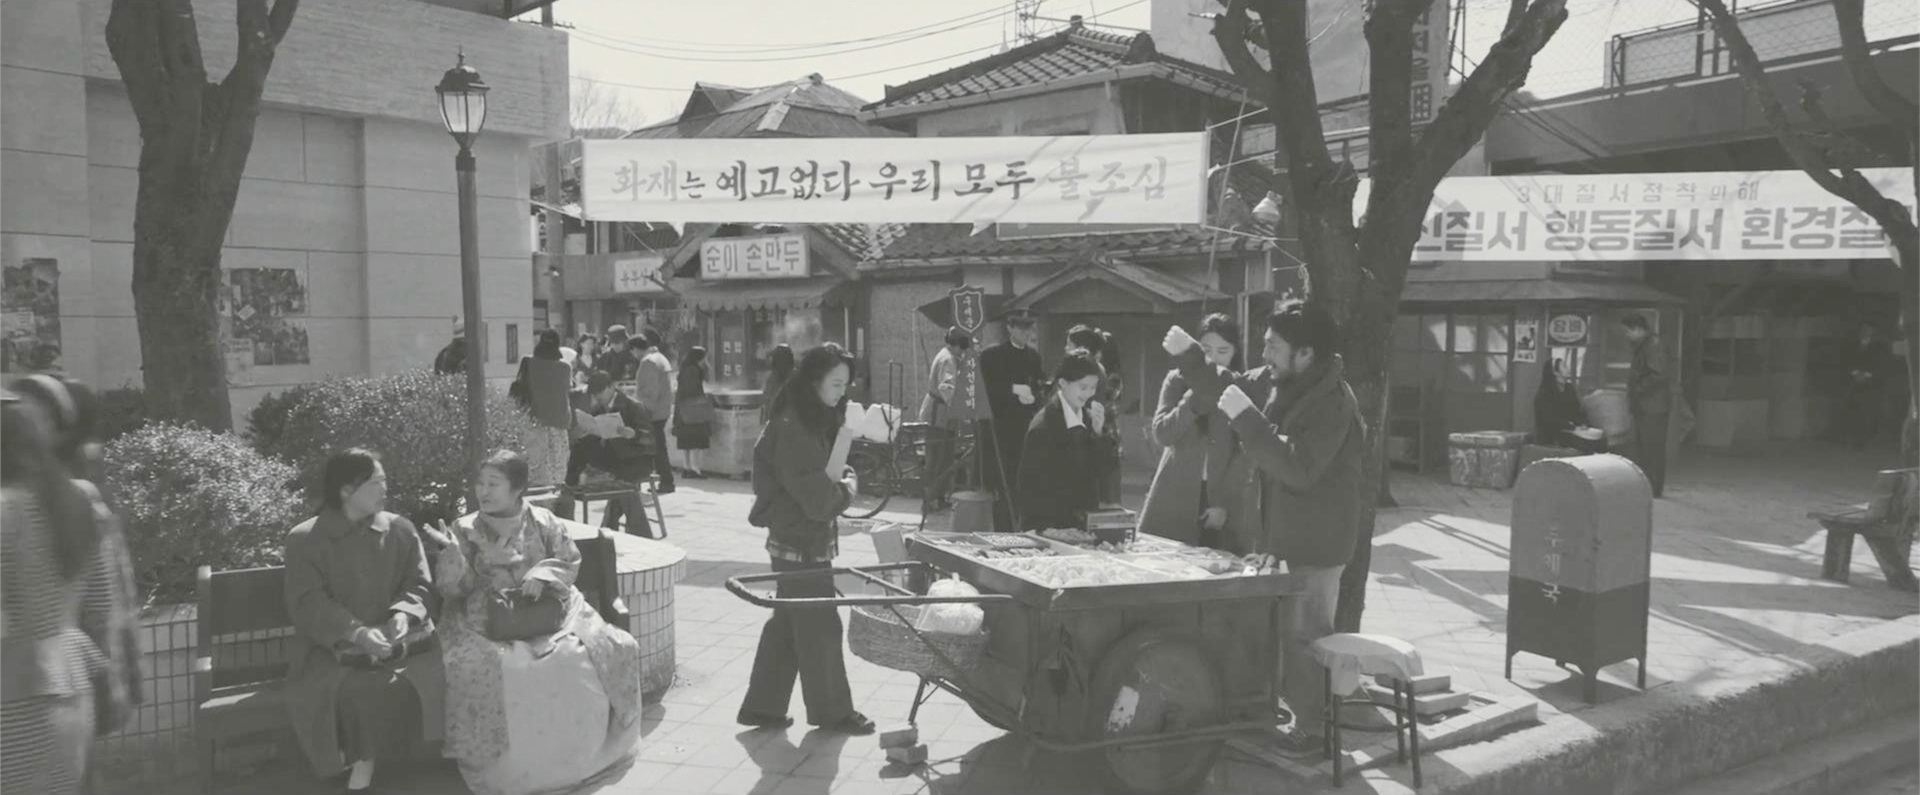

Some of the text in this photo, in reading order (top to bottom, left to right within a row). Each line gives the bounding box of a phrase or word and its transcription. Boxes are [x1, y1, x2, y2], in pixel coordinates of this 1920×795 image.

[611, 155, 1164, 201] 화재는 예고없다 우리 모두 불조심
[1544, 207, 1724, 252] 행동질서
[1741, 205, 1912, 251] 환경질
[706, 240, 800, 273] 순이 손만두
[1553, 319, 1582, 333] 담배
